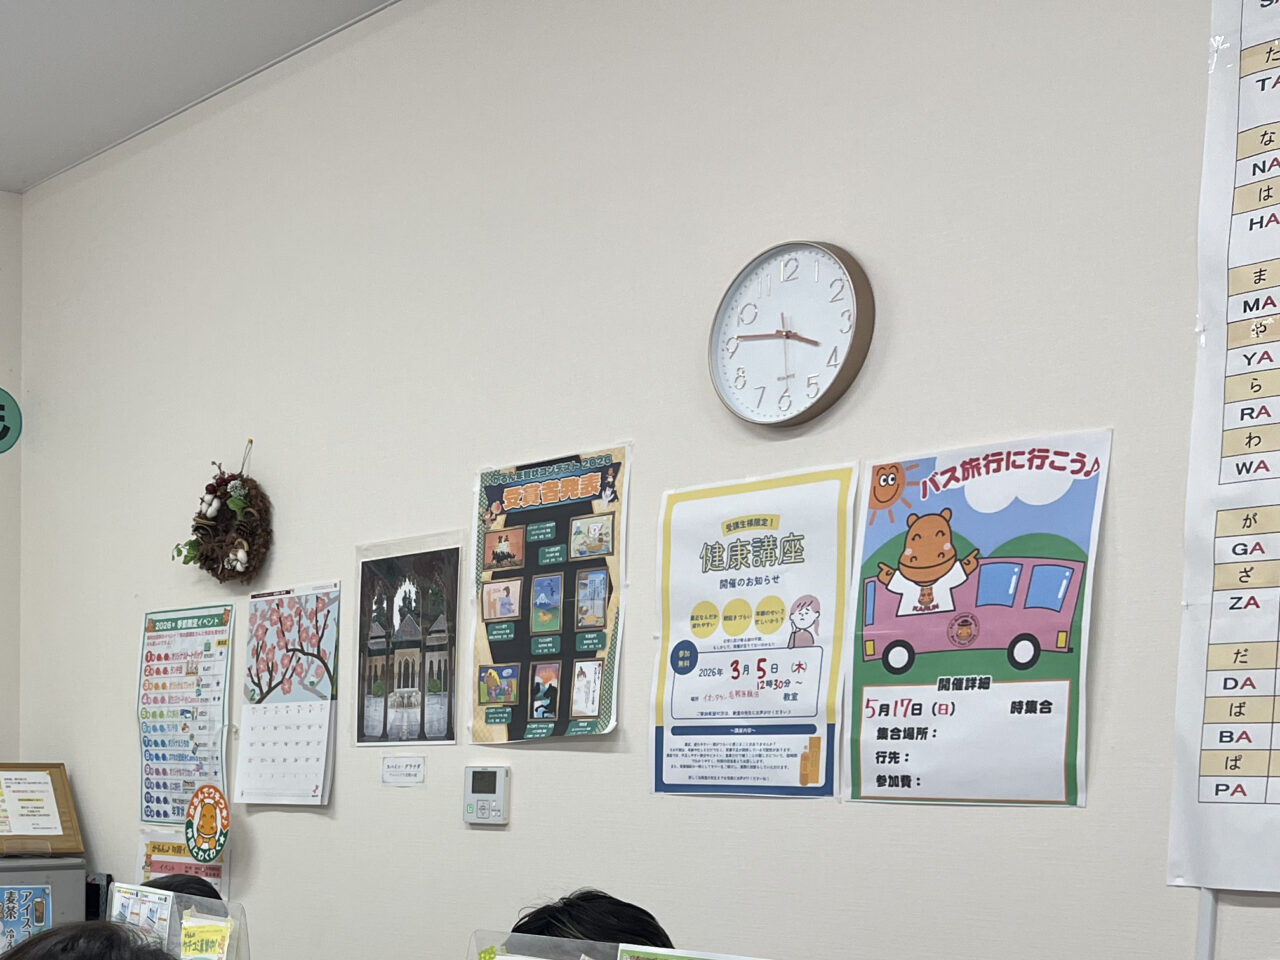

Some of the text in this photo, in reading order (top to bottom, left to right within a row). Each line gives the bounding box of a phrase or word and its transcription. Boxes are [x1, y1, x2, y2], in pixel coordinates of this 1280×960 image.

[1260, 130, 1276, 145] な
[1252, 158, 1280, 176] NA
[1258, 185, 1274, 202] は
[1248, 213, 1280, 231] HA
[780, 257, 799, 283] 12
[815, 260, 819, 283] 1
[1253, 268, 1268, 284] ま
[758, 273, 771, 299] 11
[830, 278, 845, 303] 2
[1243, 296, 1277, 313] MA
[737, 303, 758, 327] 10
[840, 309, 853, 334] 3
[1251, 323, 1267, 338] や
[726, 336, 739, 360] 9
[826, 346, 840, 369] 4
[1243, 350, 1274, 367] YA
[734, 367, 747, 390] 8
[807, 373, 820, 399] 5
[1250, 378, 1262, 393] ら
[754, 385, 766, 409] 7
[778, 388, 792, 412] 6
[1239, 405, 1271, 421] RA
[1245, 433, 1261, 448] わ
[1235, 459, 1270, 475] WA
[502, 471, 602, 511] 受賞者発表
[1242, 512, 1257, 530] が
[699, 532, 805, 574] 健康講座
[1231, 541, 1265, 556] GA
[719, 575, 781, 590] 開催のお知らせ
[1238, 567, 1254, 584] ざ
[1229, 596, 1261, 610] ZA
[1233, 648, 1249, 664] だ
[698, 667, 724, 678] 2026年
[937, 676, 991, 692] 開催詳細
[1222, 677, 1257, 691] DA
[1009, 699, 1053, 714] 時集合
[1230, 702, 1246, 718] ば
[876, 726, 938, 741] 集合場所：
[1219, 731, 1253, 744] BA
[1225, 755, 1242, 770] ぱ
[1214, 784, 1248, 798] PA
[4, 890, 18, 920] 麦茶
